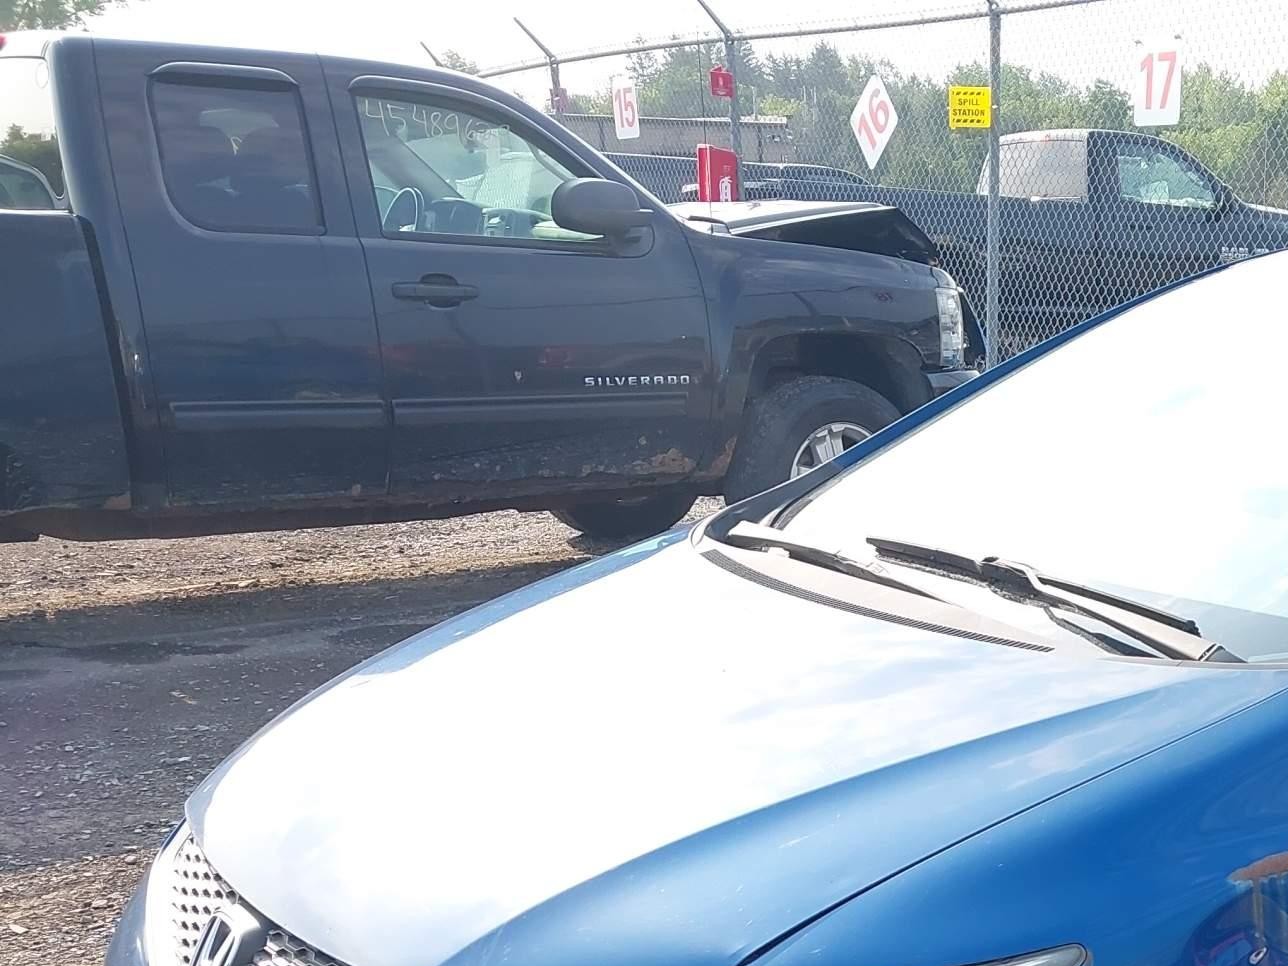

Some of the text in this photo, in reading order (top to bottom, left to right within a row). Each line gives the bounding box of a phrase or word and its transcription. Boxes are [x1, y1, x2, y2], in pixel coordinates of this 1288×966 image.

[1140, 51, 1177, 110] 17
[615, 86, 636, 129] 15
[952, 108, 985, 117] STATION
[957, 98, 981, 107] SPILL
[857, 87, 890, 151] 16
[584, 375, 690, 387] SILVERADO
